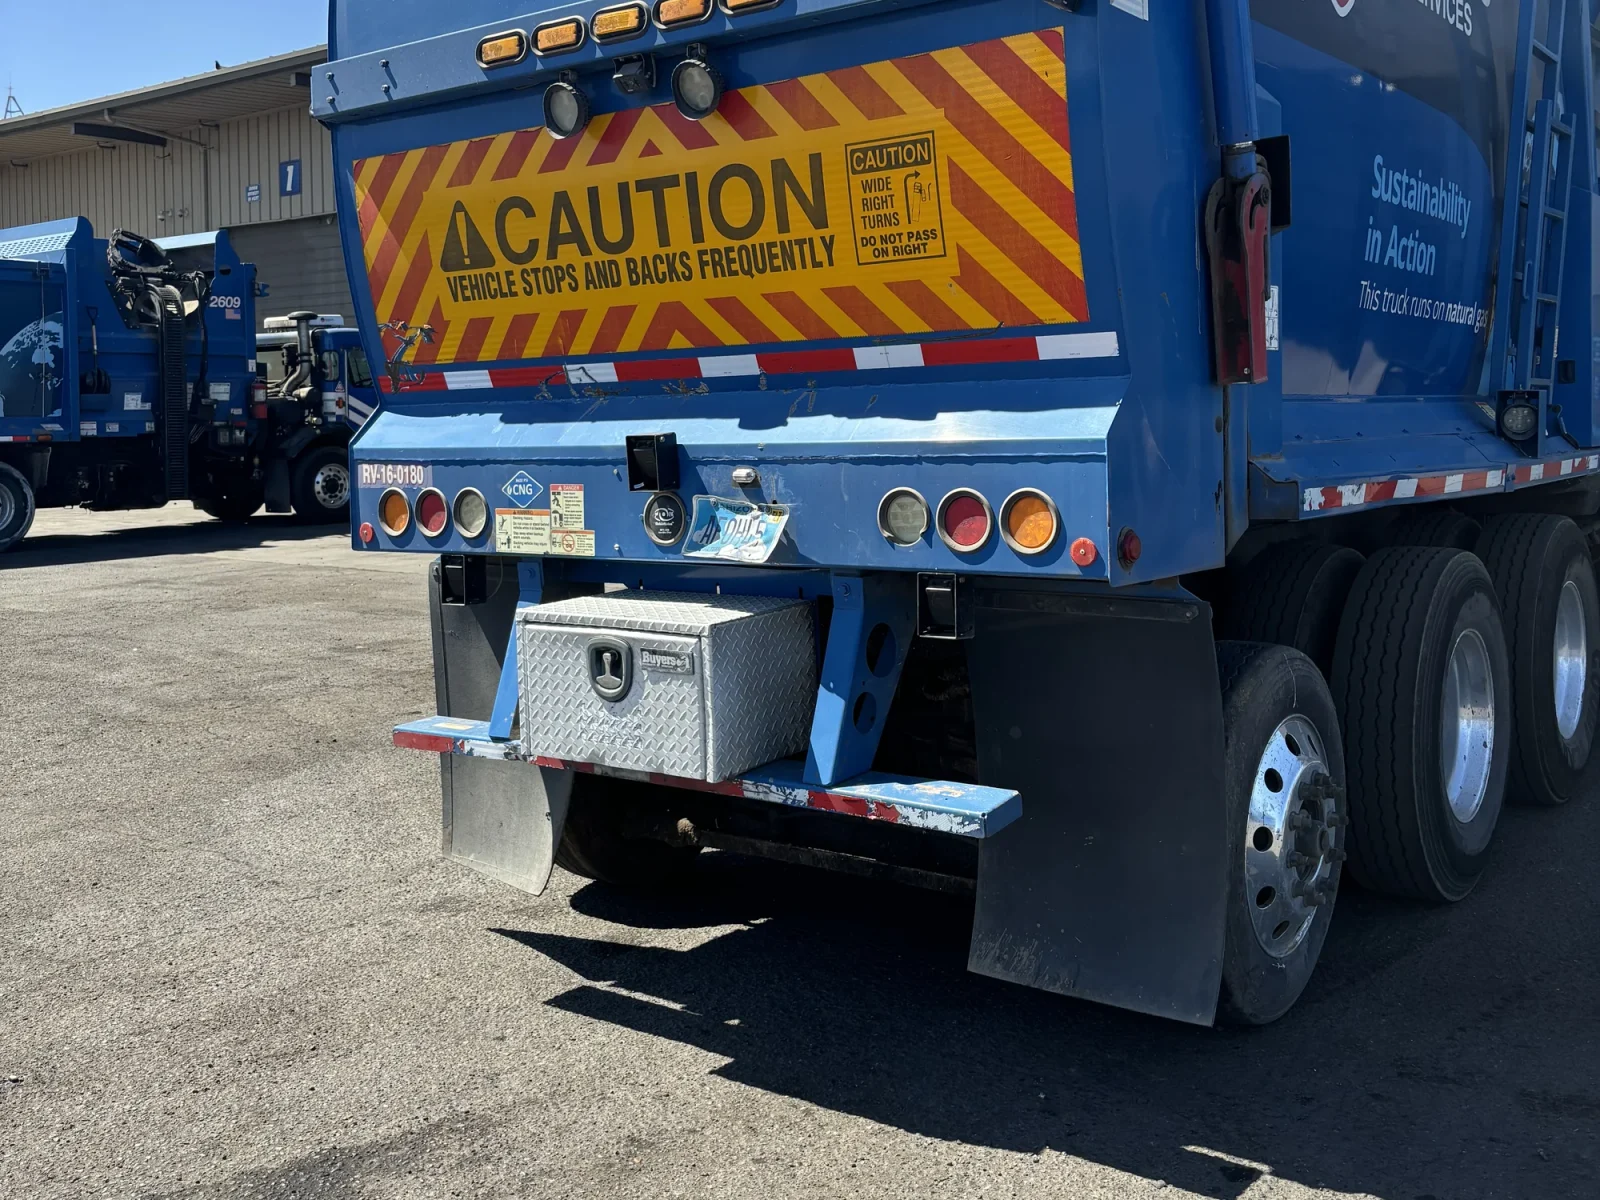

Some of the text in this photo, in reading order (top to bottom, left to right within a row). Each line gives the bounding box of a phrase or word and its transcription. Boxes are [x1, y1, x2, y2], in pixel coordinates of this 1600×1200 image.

[852, 141, 929, 171] CAUTION
[286, 165, 294, 192] 1
[861, 176, 893, 194] WIDE
[862, 194, 895, 212] RIGHT
[1371, 154, 1472, 239] Sustainability
[494, 152, 829, 266] CAUTION
[861, 211, 900, 230] TURNS
[861, 228, 938, 247] DO NOT PASS
[1364, 215, 1436, 276] in Action
[872, 242, 928, 258] ON RIGHT
[446, 234, 836, 303] VEHICLE STOPS AND BACKS FREQUENTLY
[209, 295, 241, 308] 2609
[1359, 280, 1380, 312] This
[1382, 287, 1410, 315] truck
[1409, 297, 1432, 319] runs
[1432, 300, 1446, 321] on
[1445, 301, 1478, 327] natural
[362, 463, 424, 485] RV-16-0180
[512, 483, 533, 496] CNG
[642, 650, 676, 667] Buyers
